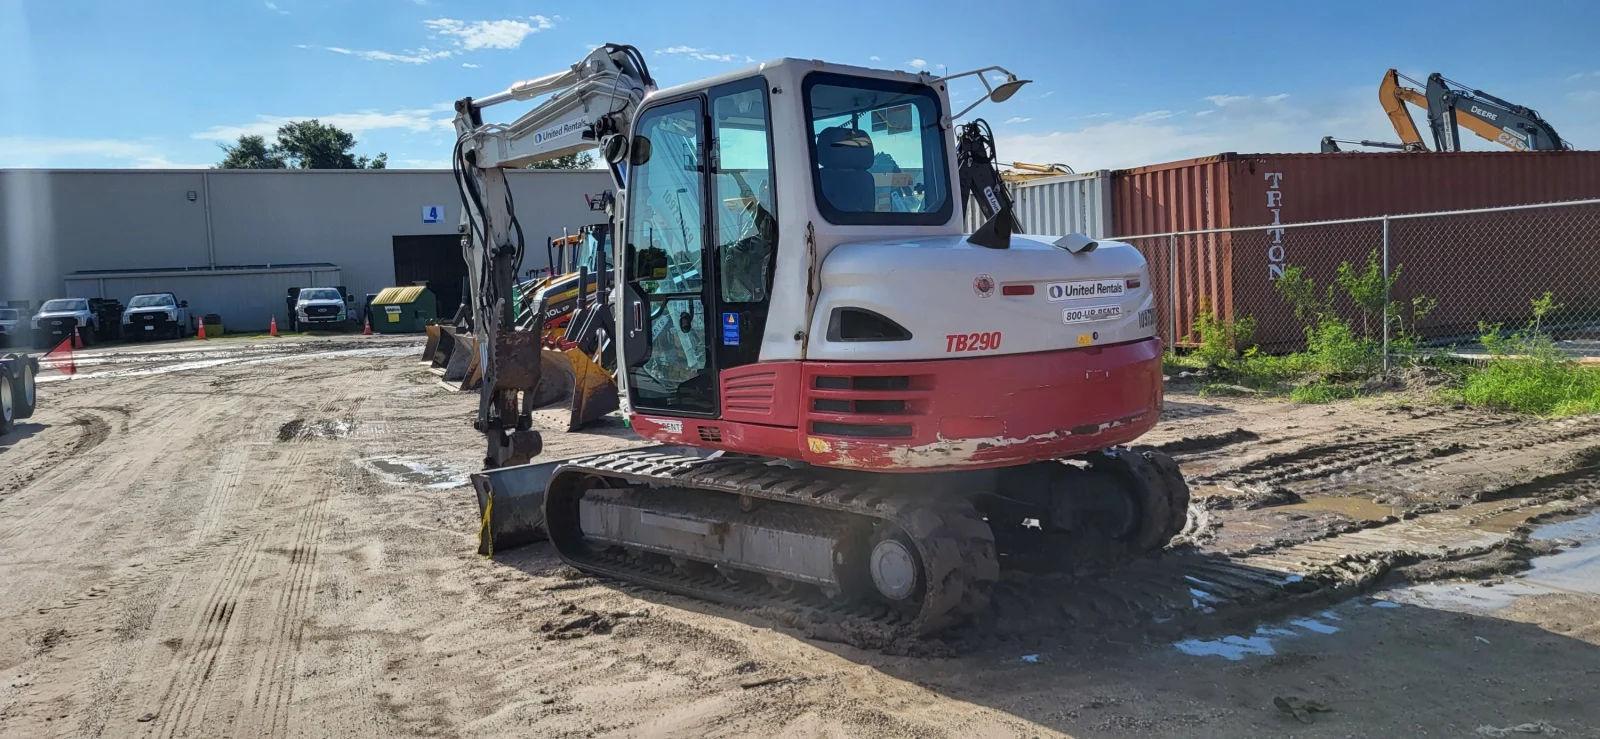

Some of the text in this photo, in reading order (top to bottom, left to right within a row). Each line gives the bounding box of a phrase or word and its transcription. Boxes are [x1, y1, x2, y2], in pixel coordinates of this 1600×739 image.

[1471, 106, 1497, 120] DEERE
[543, 119, 586, 140] United Rentals
[430, 207, 437, 220] 4
[1265, 173, 1286, 280] TRITON
[1065, 282, 1122, 296] United Rentals
[946, 331, 1002, 352] TB290
